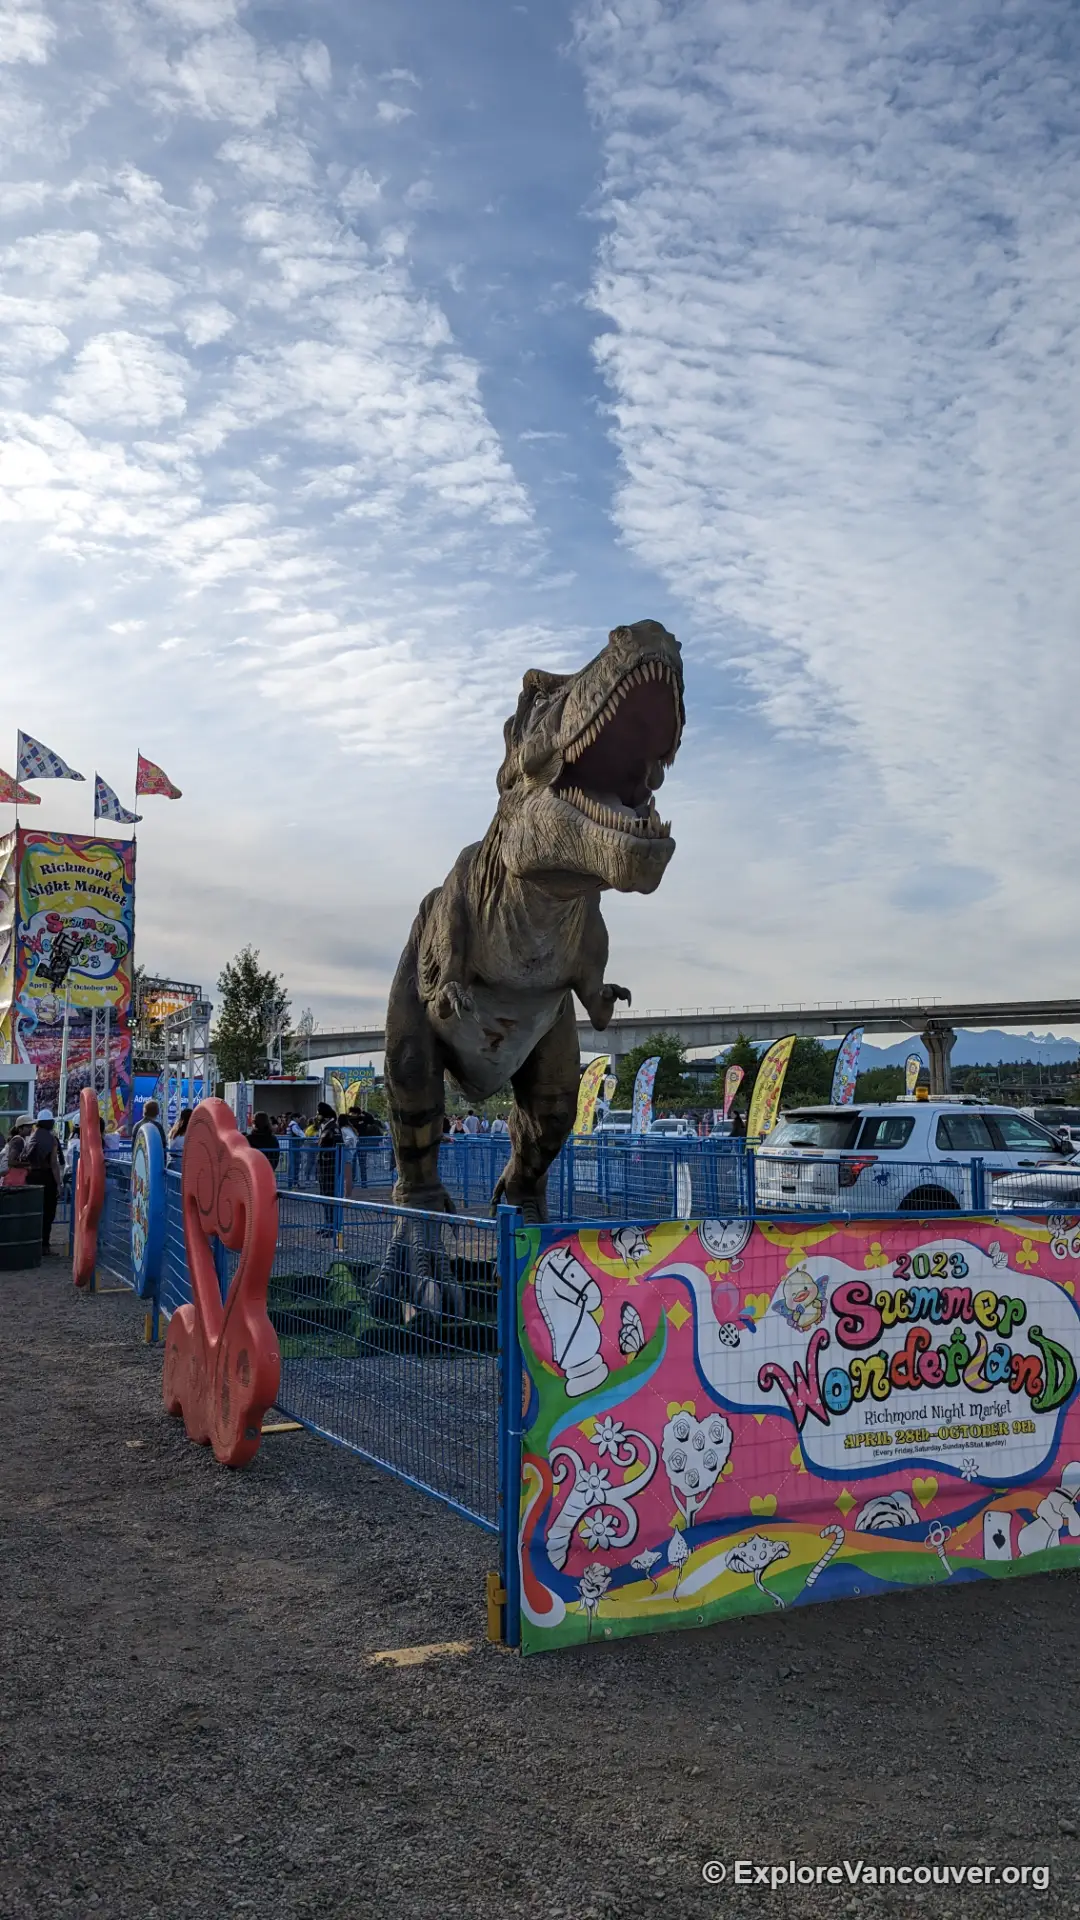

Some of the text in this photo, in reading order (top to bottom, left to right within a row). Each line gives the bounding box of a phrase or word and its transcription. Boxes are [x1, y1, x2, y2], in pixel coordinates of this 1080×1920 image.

[40, 862, 112, 882] Richmond
[27, 880, 127, 907] Night Market
[45, 912, 115, 935] Summer
[68, 955, 101, 968] 023
[893, 1252, 969, 1281] 2023
[830, 1280, 1027, 1350] Summer
[864, 1400, 1012, 1425] Richmond Night Market
[844, 1431, 892, 1449] APRIL
[1012, 1419, 1036, 1434] 9th
